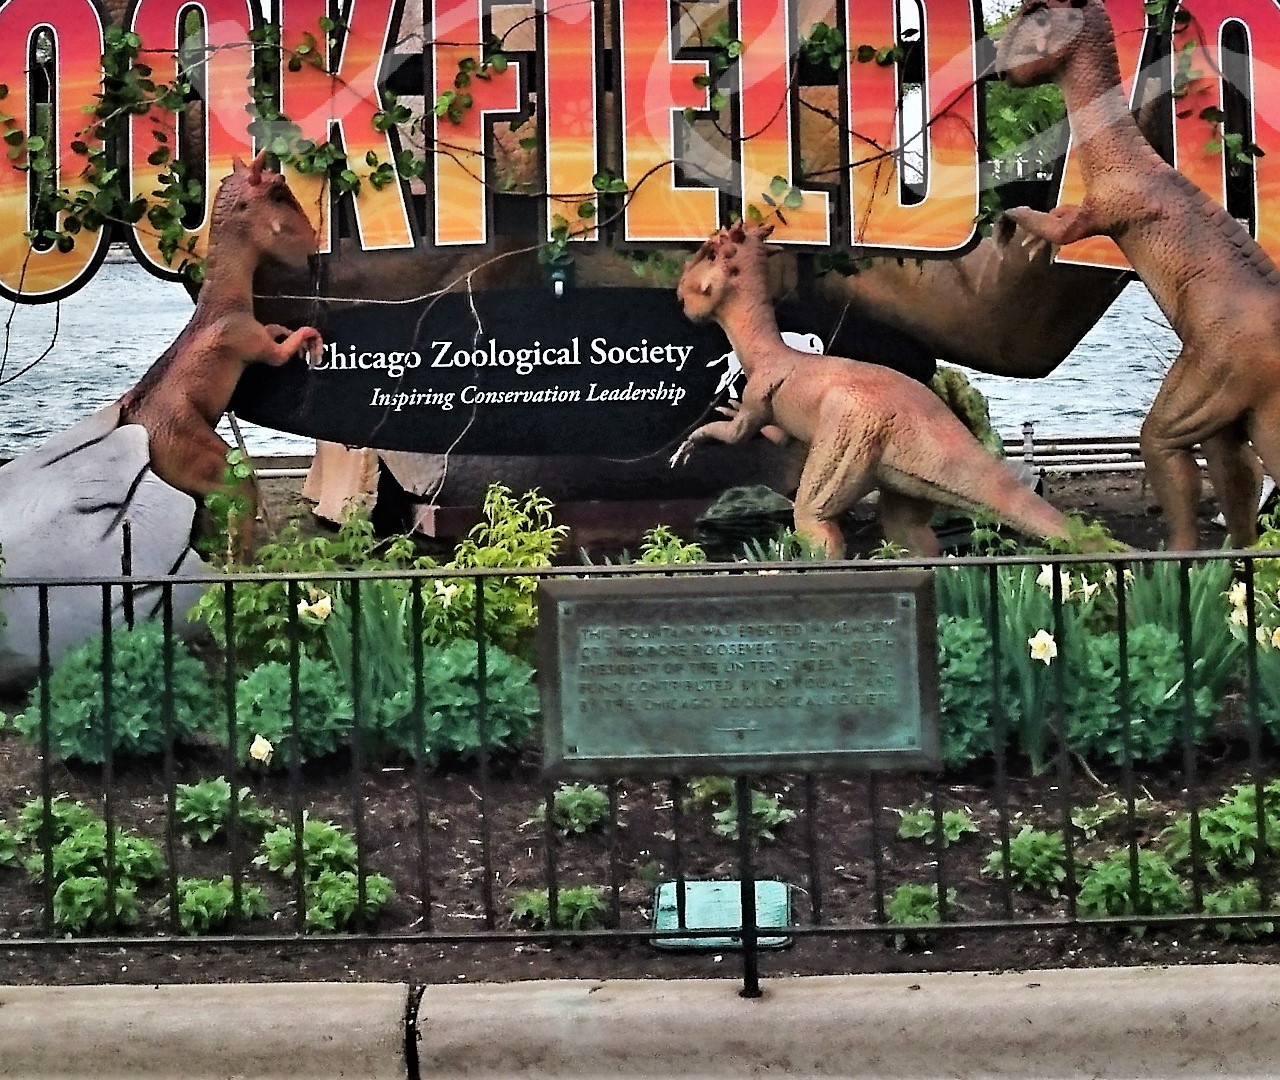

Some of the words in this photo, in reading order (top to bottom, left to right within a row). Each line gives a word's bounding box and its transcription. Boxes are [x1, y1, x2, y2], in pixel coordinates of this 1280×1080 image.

[307, 342, 421, 377] Chicago
[431, 336, 581, 375] Zoological
[590, 331, 694, 369] Society
[370, 388, 455, 412] Inspiring
[460, 385, 581, 407] Conservation
[585, 382, 687, 405] Leadership
